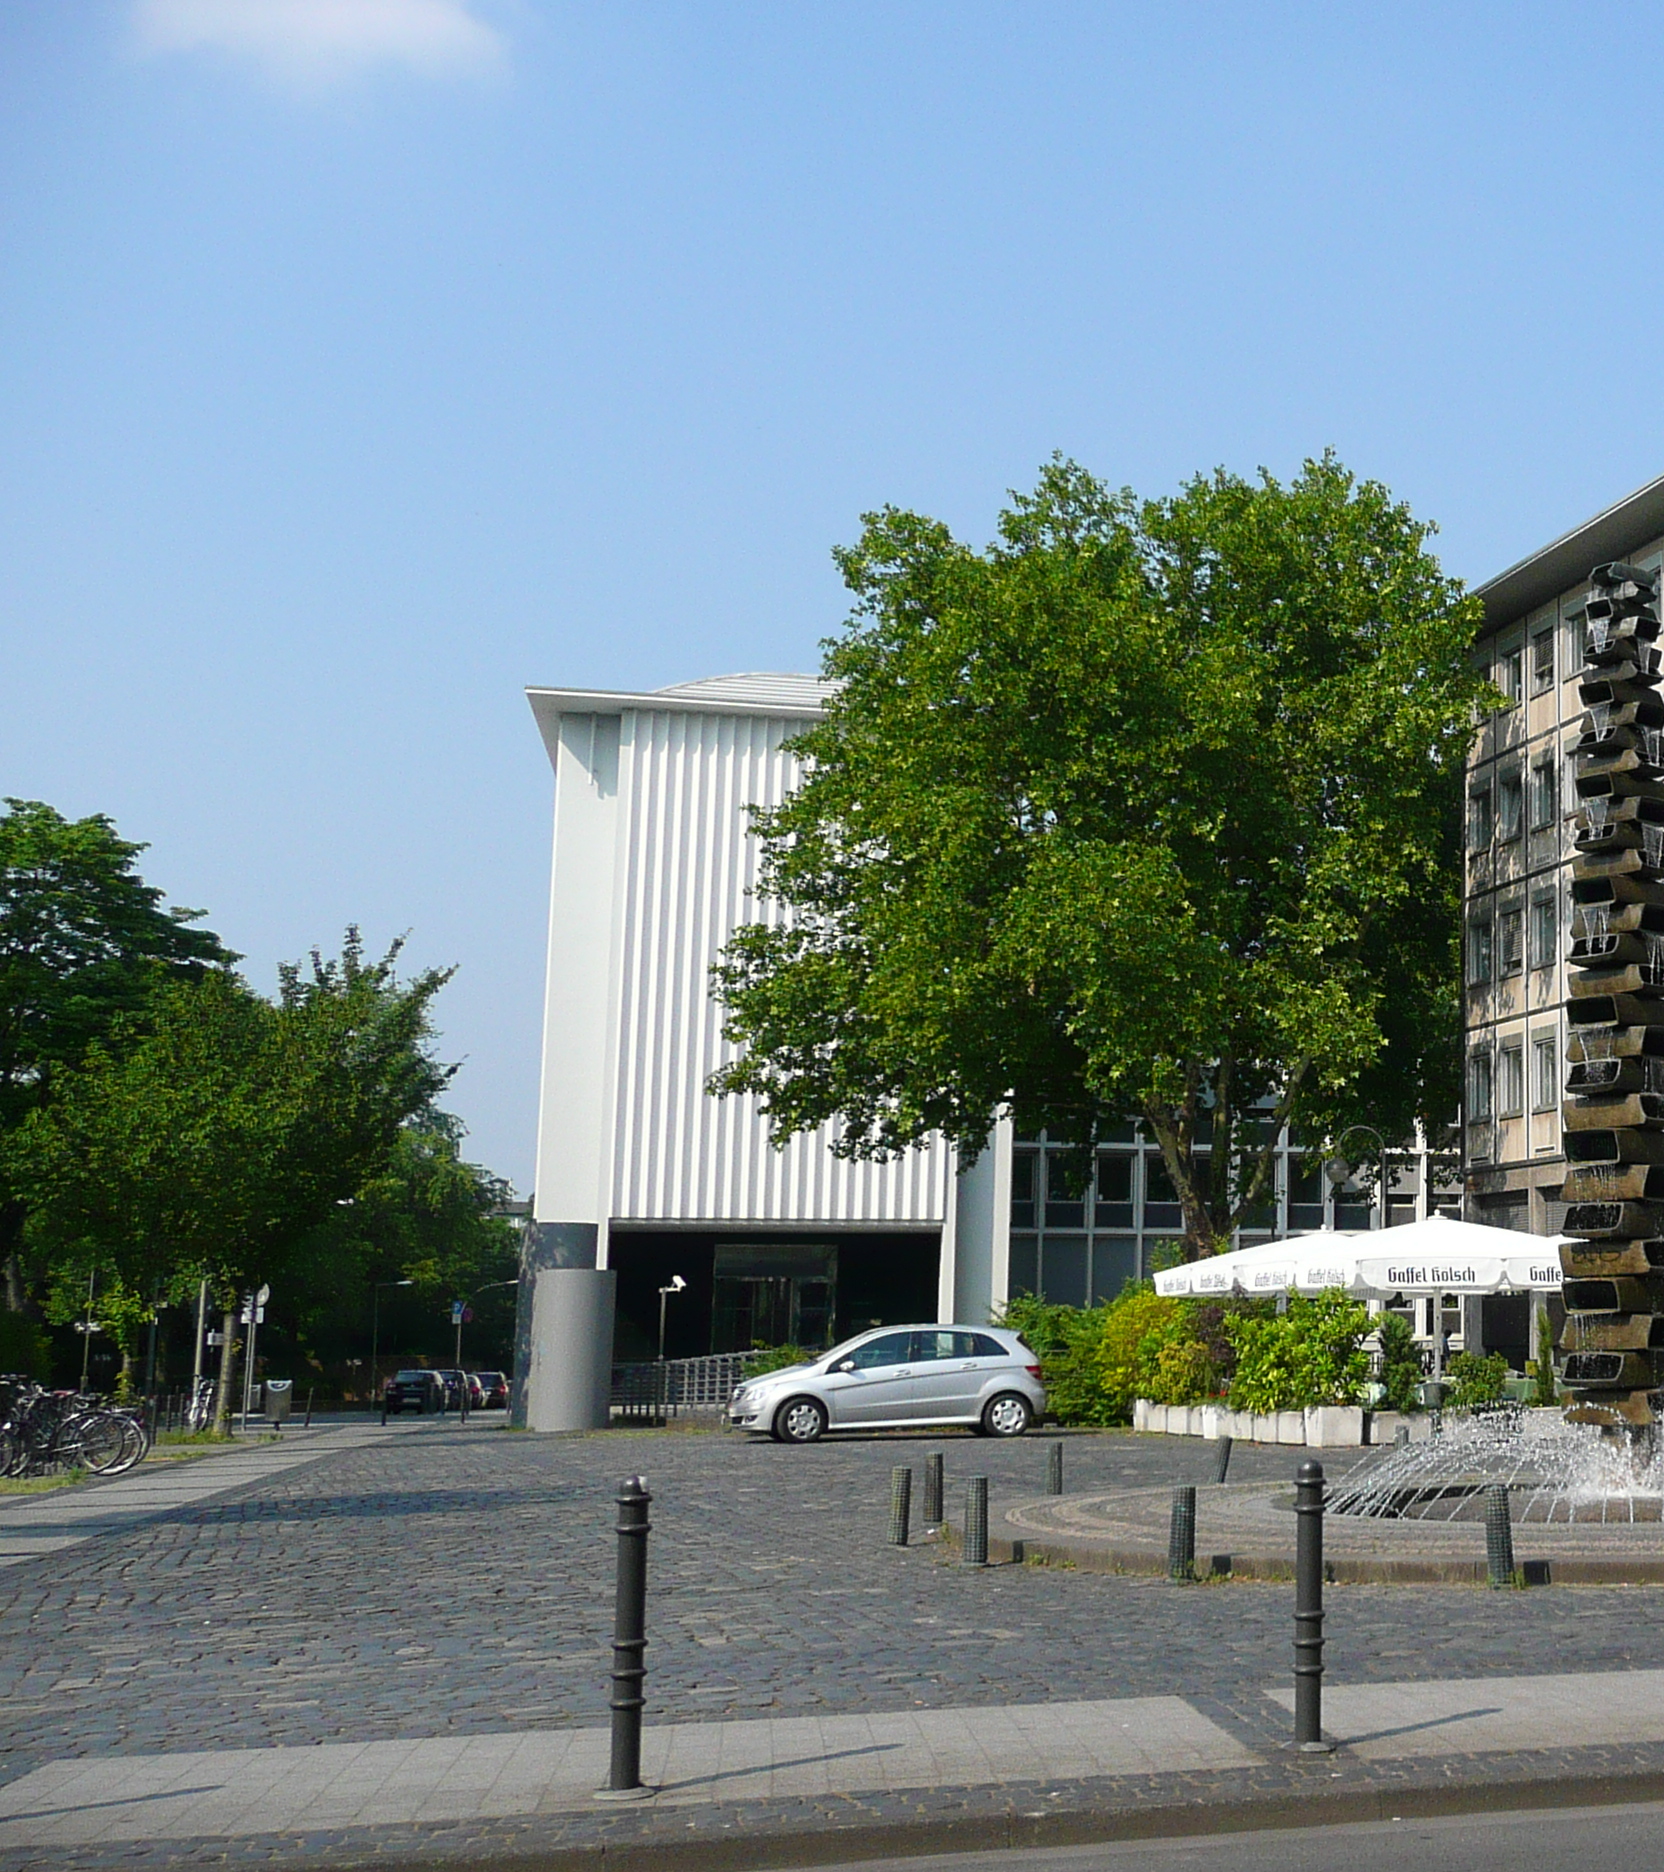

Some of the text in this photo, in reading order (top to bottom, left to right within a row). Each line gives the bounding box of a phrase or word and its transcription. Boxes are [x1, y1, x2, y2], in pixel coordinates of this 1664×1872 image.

[1388, 1266, 1475, 1284] Gaffel Kölsch
[1530, 1266, 1561, 1283] Gaffe
